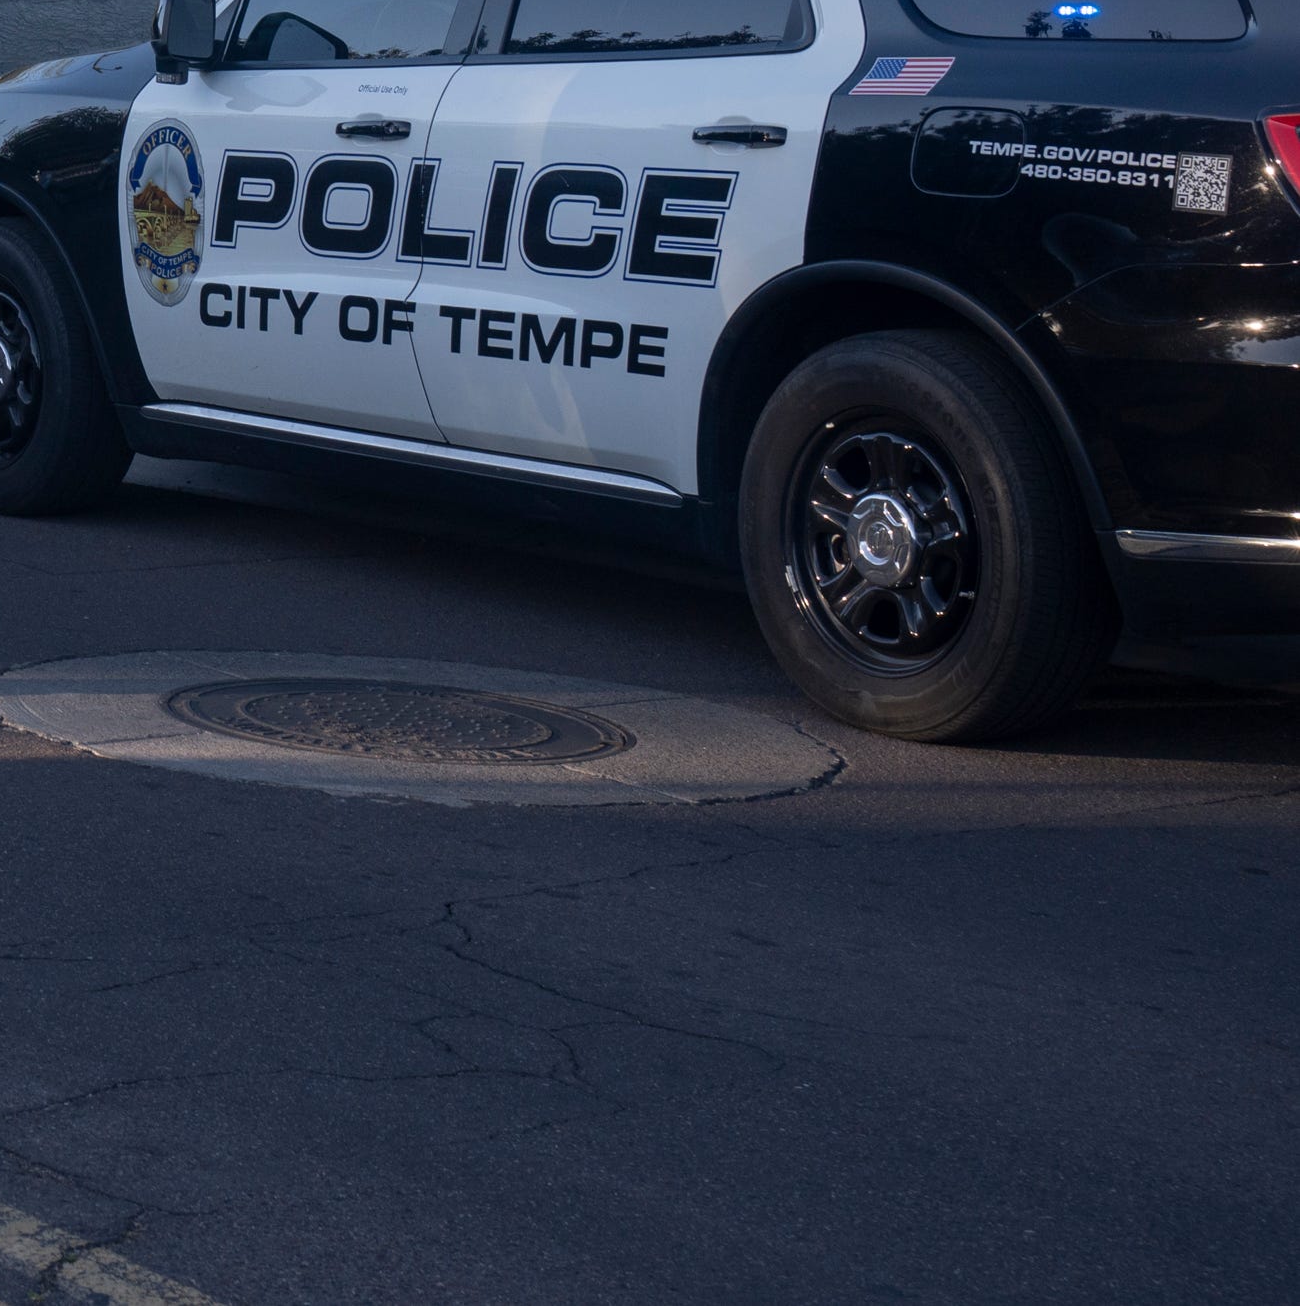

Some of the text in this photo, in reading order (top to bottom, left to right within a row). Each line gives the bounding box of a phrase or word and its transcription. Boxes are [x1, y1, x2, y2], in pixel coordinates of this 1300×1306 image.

[143, 127, 192, 161] OFFICER
[969, 140, 1176, 169] TEMPE.GOV/POLICE
[211, 149, 740, 288] POLICE
[141, 245, 193, 266] CITY OF TEMPE
[151, 264, 182, 278] POLICE
[199, 282, 669, 379] CITY OF TEMPE
